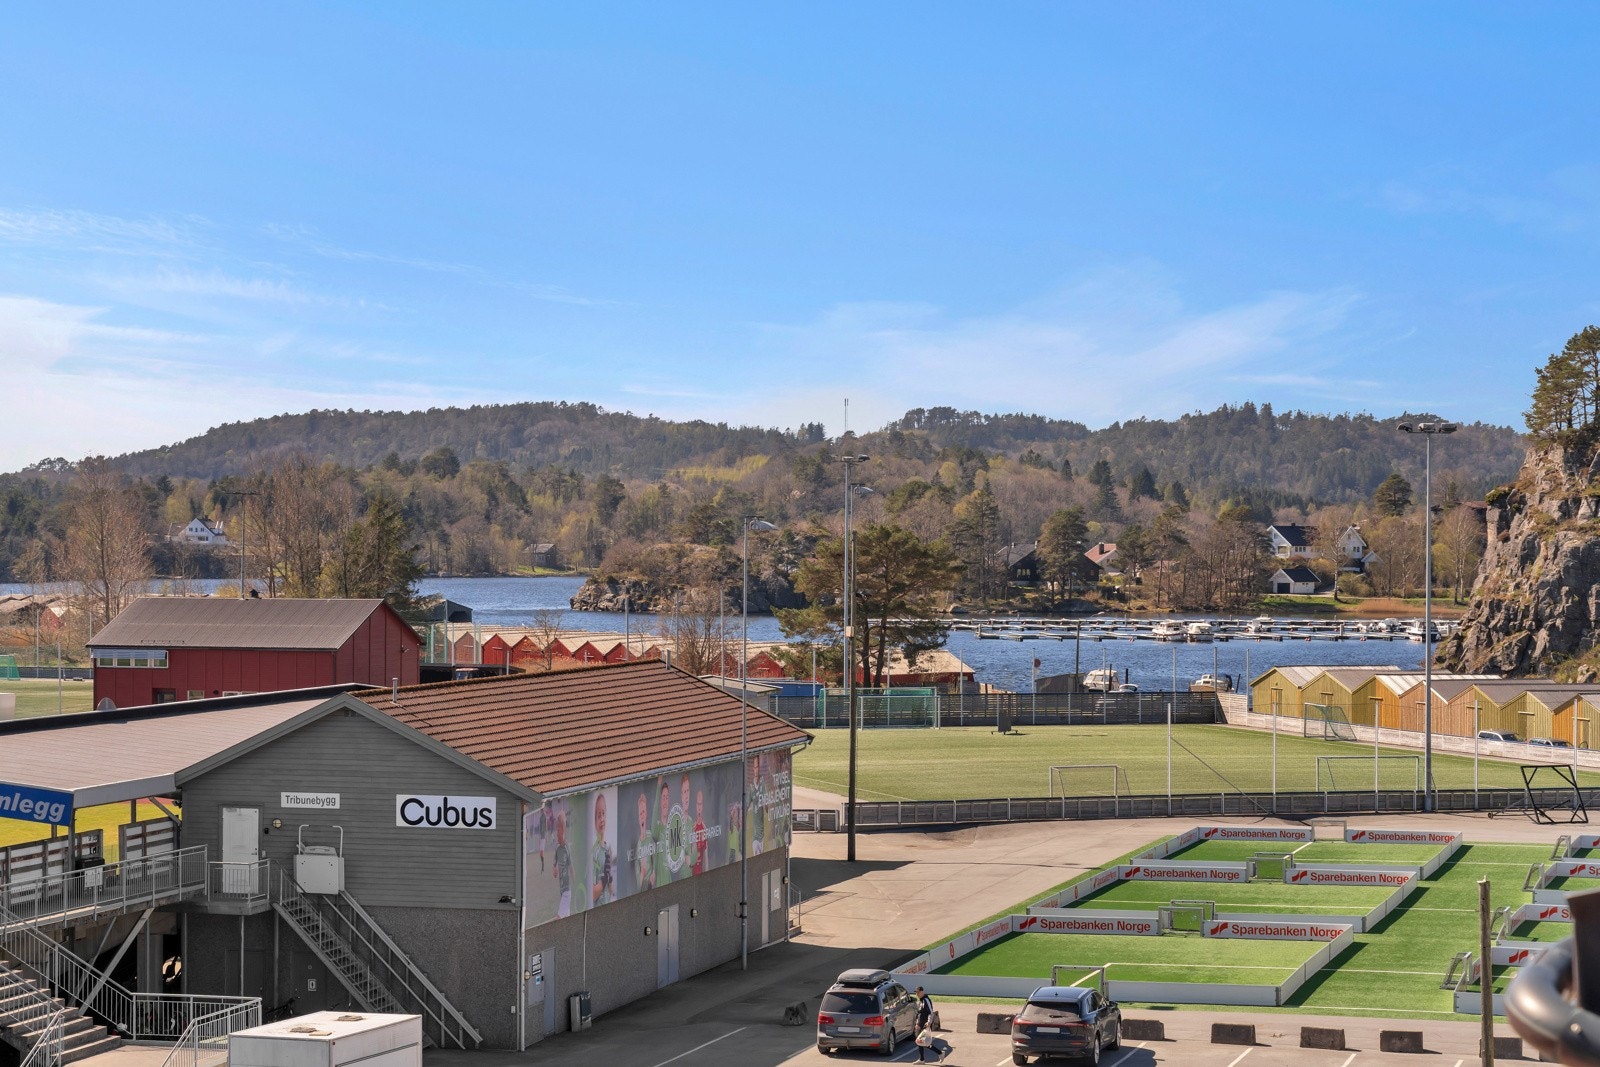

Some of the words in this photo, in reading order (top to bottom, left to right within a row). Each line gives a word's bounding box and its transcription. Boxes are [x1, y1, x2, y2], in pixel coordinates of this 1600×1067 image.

[285, 795, 336, 807] Tribunebygg
[400, 796, 493, 828] Cubus
[1220, 829, 1277, 839] Sparebanken
[1279, 830, 1306, 840] Norge
[1368, 831, 1426, 841] Sparebanken
[1428, 833, 1455, 843] Norge
[1143, 868, 1207, 879] Sparebanken
[1210, 870, 1240, 880] Norge
[1310, 872, 1376, 882] Sparebanken
[1378, 873, 1409, 885] Norge
[1040, 918, 1114, 931] Sparebanken
[1117, 920, 1151, 933] Norge
[1231, 924, 1307, 937] Sparebanken
